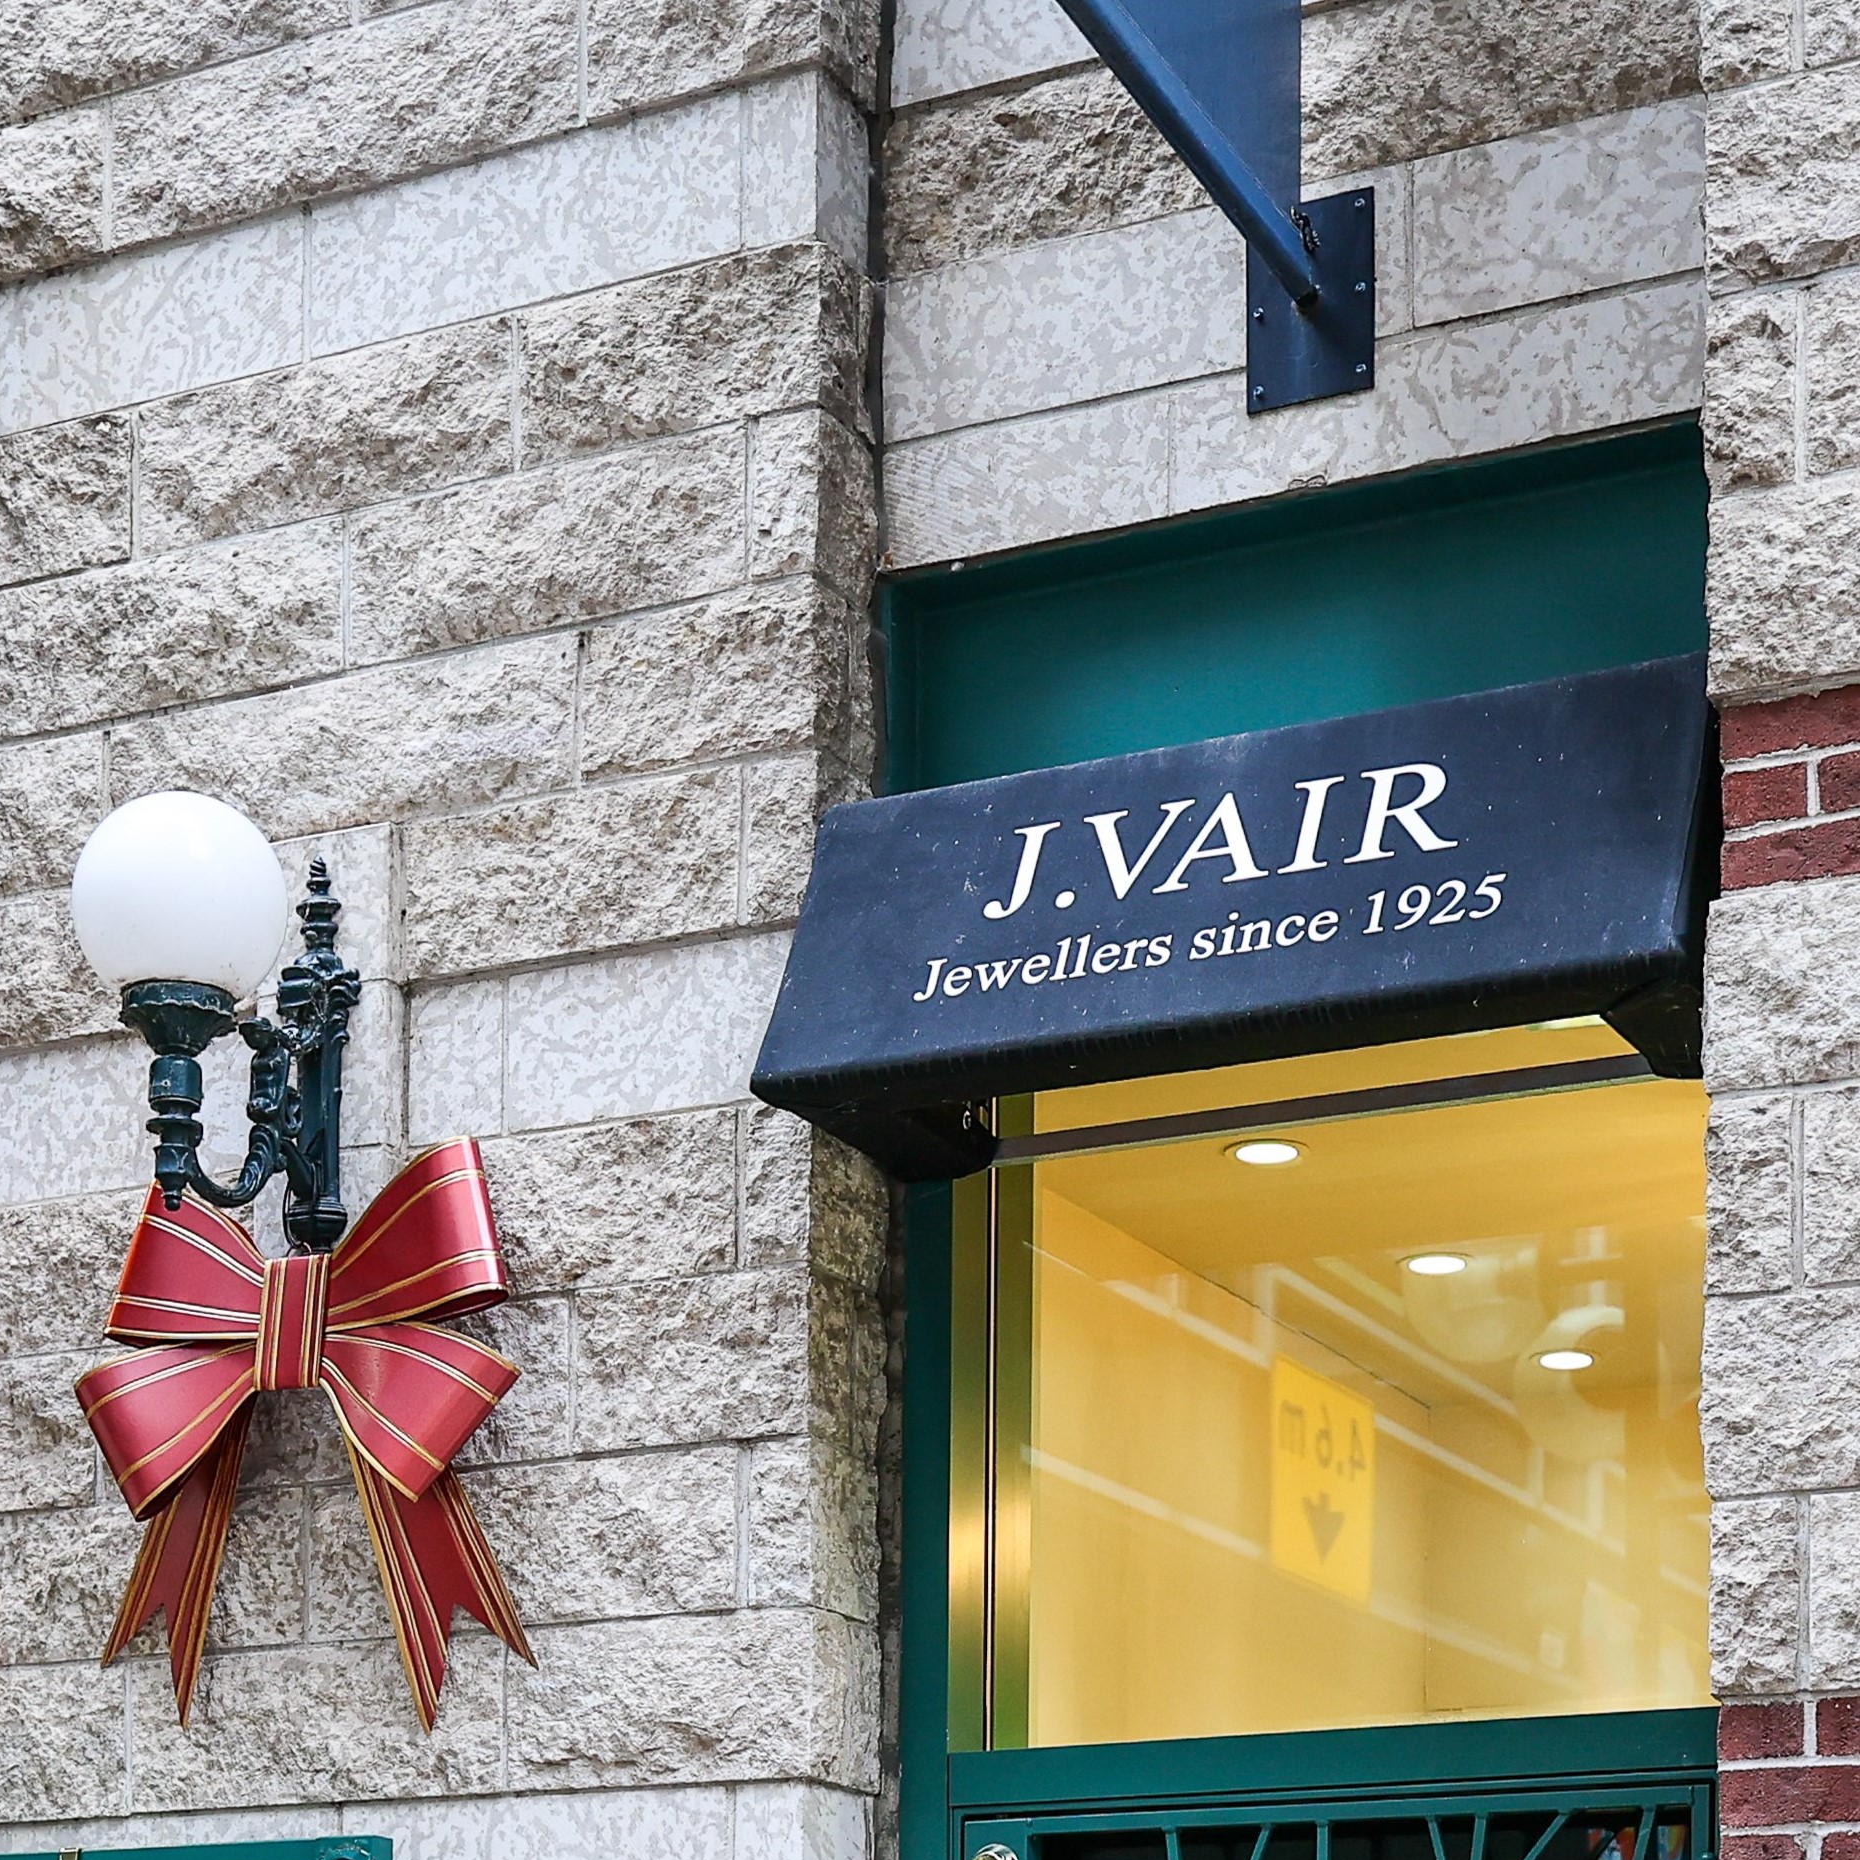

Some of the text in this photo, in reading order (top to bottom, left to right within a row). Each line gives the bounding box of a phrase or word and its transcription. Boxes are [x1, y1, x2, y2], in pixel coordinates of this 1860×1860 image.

[982, 762, 1459, 921] J.VAIR
[911, 872, 1508, 1003] Jewellers since 1925
